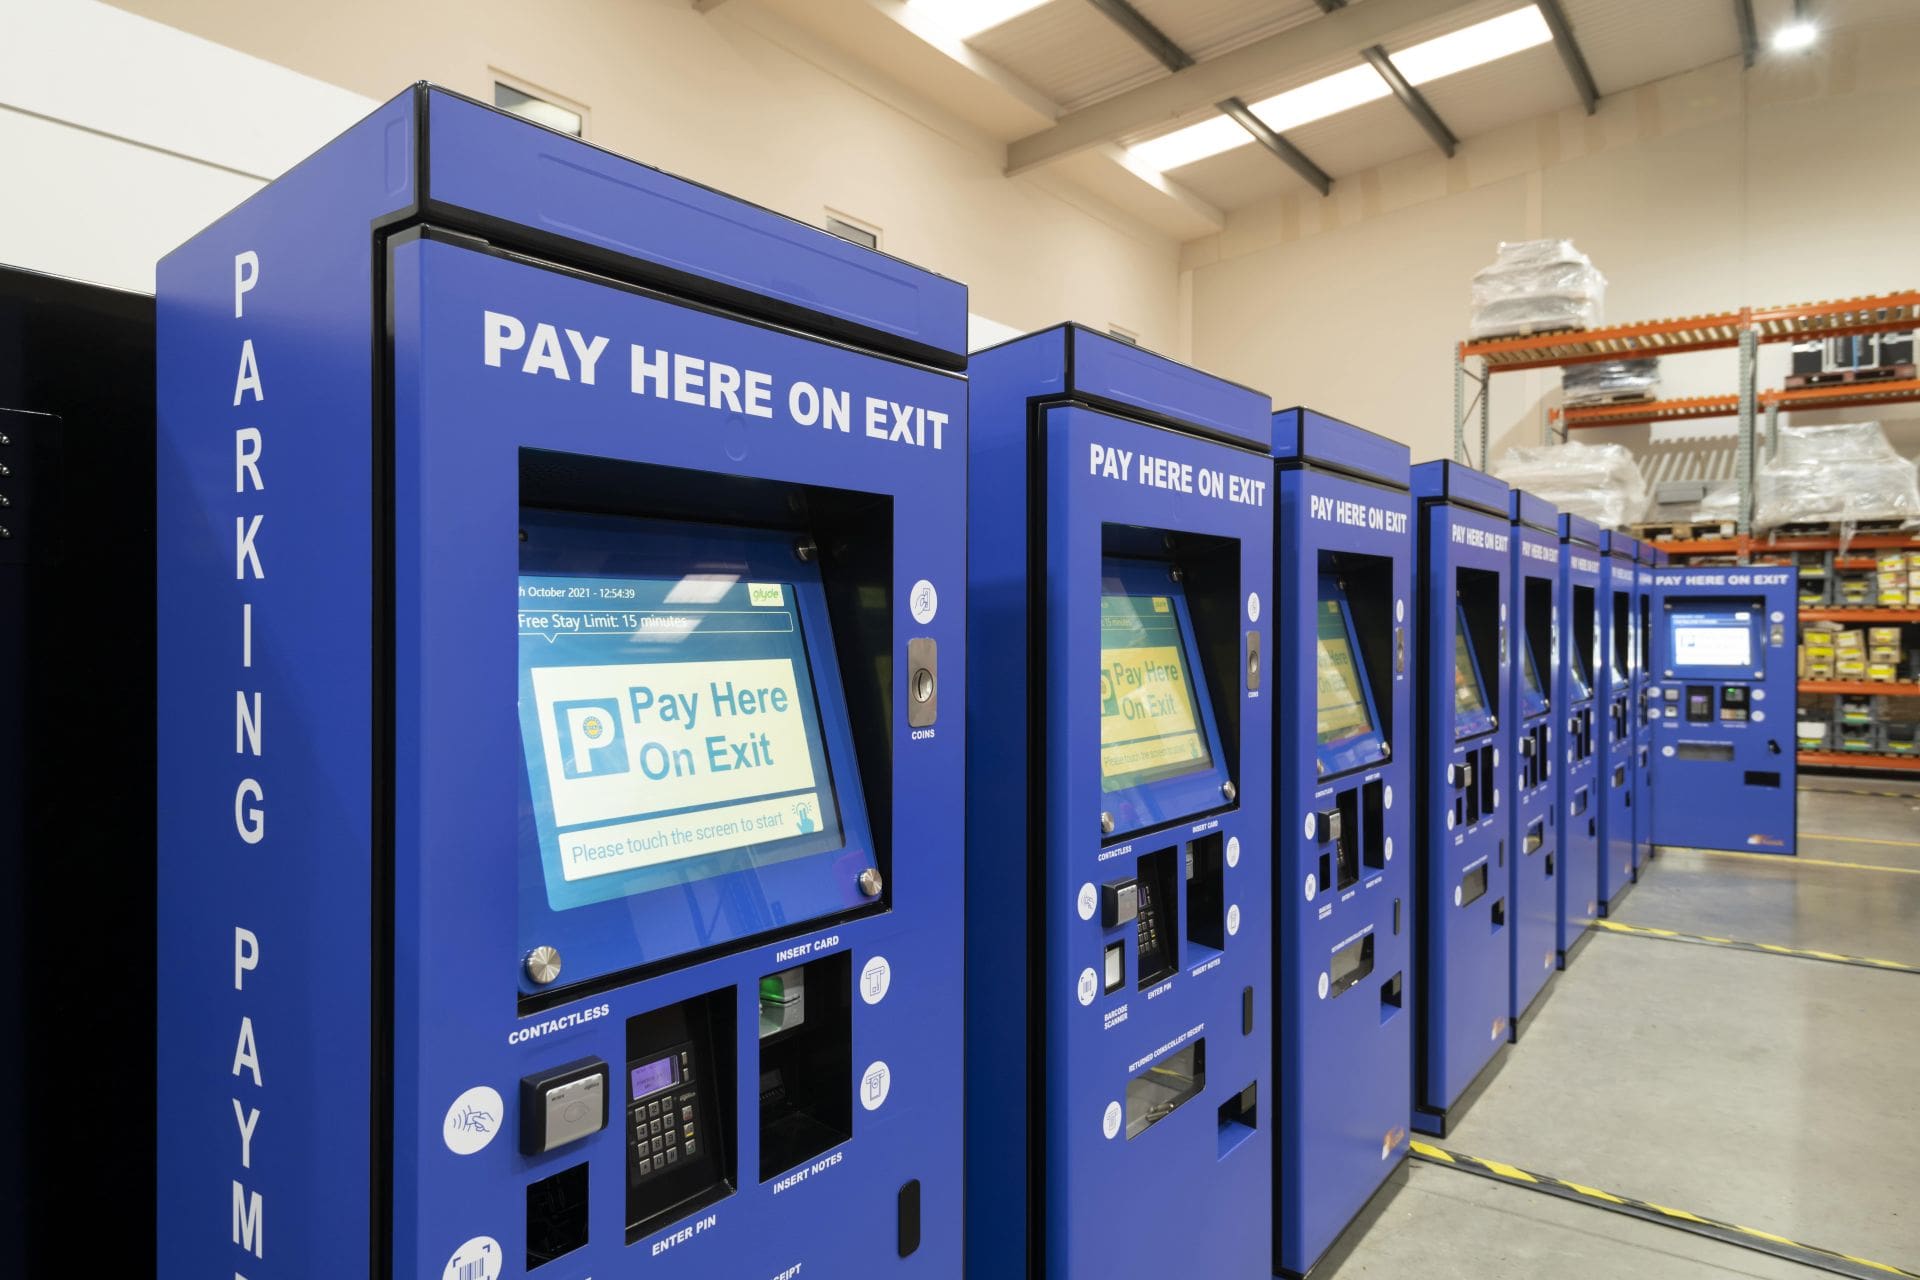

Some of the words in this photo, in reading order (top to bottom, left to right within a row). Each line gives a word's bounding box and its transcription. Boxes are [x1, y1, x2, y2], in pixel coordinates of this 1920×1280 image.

[484, 310, 610, 386] PAY
[631, 343, 773, 419] HERE
[788, 381, 850, 433] ON
[865, 396, 949, 450] EXIT
[1090, 443, 1133, 481] PAY
[1139, 454, 1193, 494] HERE
[1198, 468, 1224, 500] ON
[1229, 474, 1266, 507] EXIT
[1310, 494, 1333, 521] PAY
[1336, 500, 1367, 527] HERE
[1368, 507, 1384, 530] ON
[1385, 510, 1408, 534] EXIT
[233, 250, 265, 844] PARKING
[1452, 524, 1466, 544] PAY
[1466, 528, 1484, 548] HERE
[1485, 532, 1494, 550] ON
[1494, 534, 1508, 552] EXIT
[528, 586, 566, 598] October
[568, 588, 590, 598] 2021
[599, 588, 636, 599] 12:54:39
[1655, 575, 1682, 586] PAY
[1685, 575, 1725, 586] HERE
[1727, 574, 1751, 585] ON
[1753, 574, 1789, 585] EXIT
[518, 614, 549, 628] Free
[552, 613, 580, 631] Stay
[584, 614, 620, 629] Limit:
[622, 615, 638, 628] 15
[640, 615, 688, 629] minutes
[1113, 662, 1142, 689] Pay
[1144, 660, 1179, 683] Here
[628, 685, 699, 731] Pay
[710, 681, 789, 718] Here
[1122, 696, 1146, 720] On
[1147, 693, 1177, 718] Exit
[911, 724, 935, 740] COINS
[639, 741, 696, 781] On
[704, 731, 775, 773] Exit
[571, 841, 625, 864] Please
[627, 830, 669, 854] touch
[671, 827, 694, 845] the
[696, 821, 739, 841] screen
[741, 817, 754, 832] to
[756, 811, 785, 830] start
[1098, 844, 1132, 862] CONTACTLESS
[776, 941, 811, 963] INSERT
[811, 935, 840, 954] CARD
[1147, 986, 1163, 1000] ENTER
[508, 1003, 610, 1045] CONTACTLESS
[1104, 1004, 1128, 1021] BARCODE
[232, 926, 263, 1280] PAYM
[773, 1167, 810, 1195] INSERT
[811, 1150, 843, 1176] NOTES
[652, 1226, 693, 1257] ENTER
[696, 1214, 716, 1238] PIN
[773, 1262, 802, 1280] EIPT
